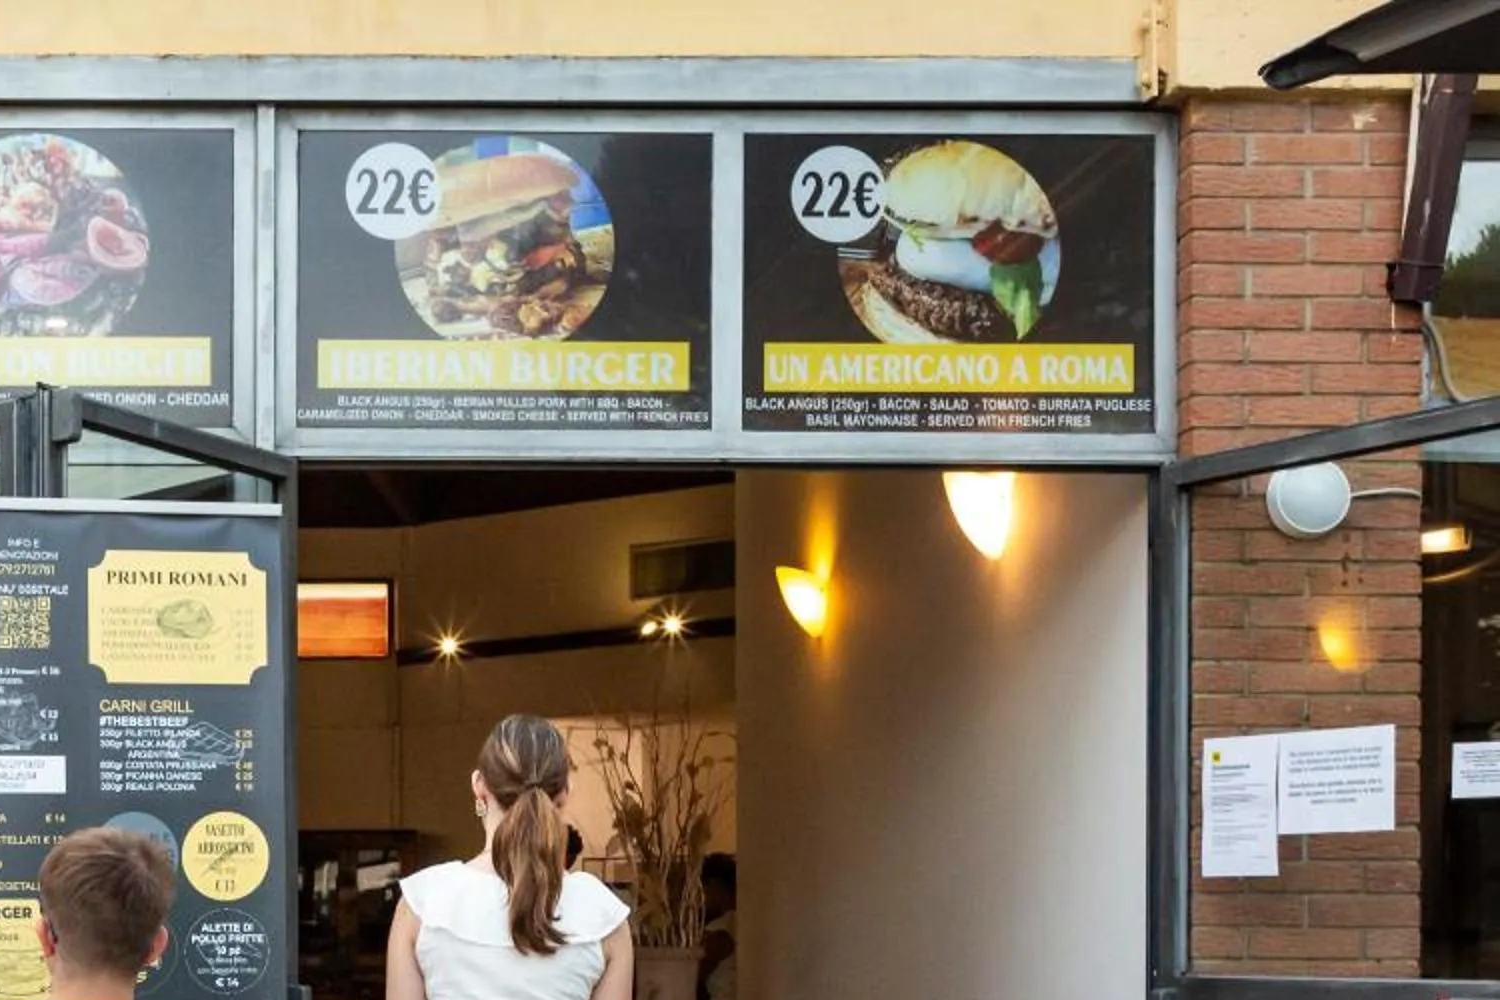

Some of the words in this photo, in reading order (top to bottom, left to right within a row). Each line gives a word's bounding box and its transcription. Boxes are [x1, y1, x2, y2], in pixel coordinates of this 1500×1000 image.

[355, 167, 436, 216] 22€
[800, 170, 882, 219] 22€
[329, 351, 494, 383] IBERIAN
[512, 352, 676, 385] BURGER
[769, 354, 808, 384] UN
[820, 354, 998, 384] AMERICANO
[1007, 355, 1030, 384] A
[1039, 355, 1129, 384] ROMA
[115, 393, 156, 406] ONION
[167, 393, 229, 406] CHEDDAR
[745, 397, 786, 409] BLACK
[787, 397, 829, 409] ANGUS
[880, 398, 921, 410] BACON
[930, 398, 969, 410] SALAD
[982, 398, 1030, 410] TOMATO
[1039, 398, 1092, 411] BURRATA
[1095, 398, 1151, 411] PUGLIESE
[806, 414, 838, 427] BASIL
[842, 414, 918, 427] MAYONNAISE
[927, 414, 975, 427] SERVED
[978, 415, 1006, 427] WITH
[1008, 415, 1050, 427] FRENCH
[1054, 415, 1092, 427] FRIES
[107, 571, 162, 585] PRIMI
[169, 571, 247, 586] ROMANI
[99, 700, 147, 713] CARNI
[150, 700, 194, 713] GRILL
[201, 923, 240, 932] ALETTE
[243, 923, 254, 932] DI
